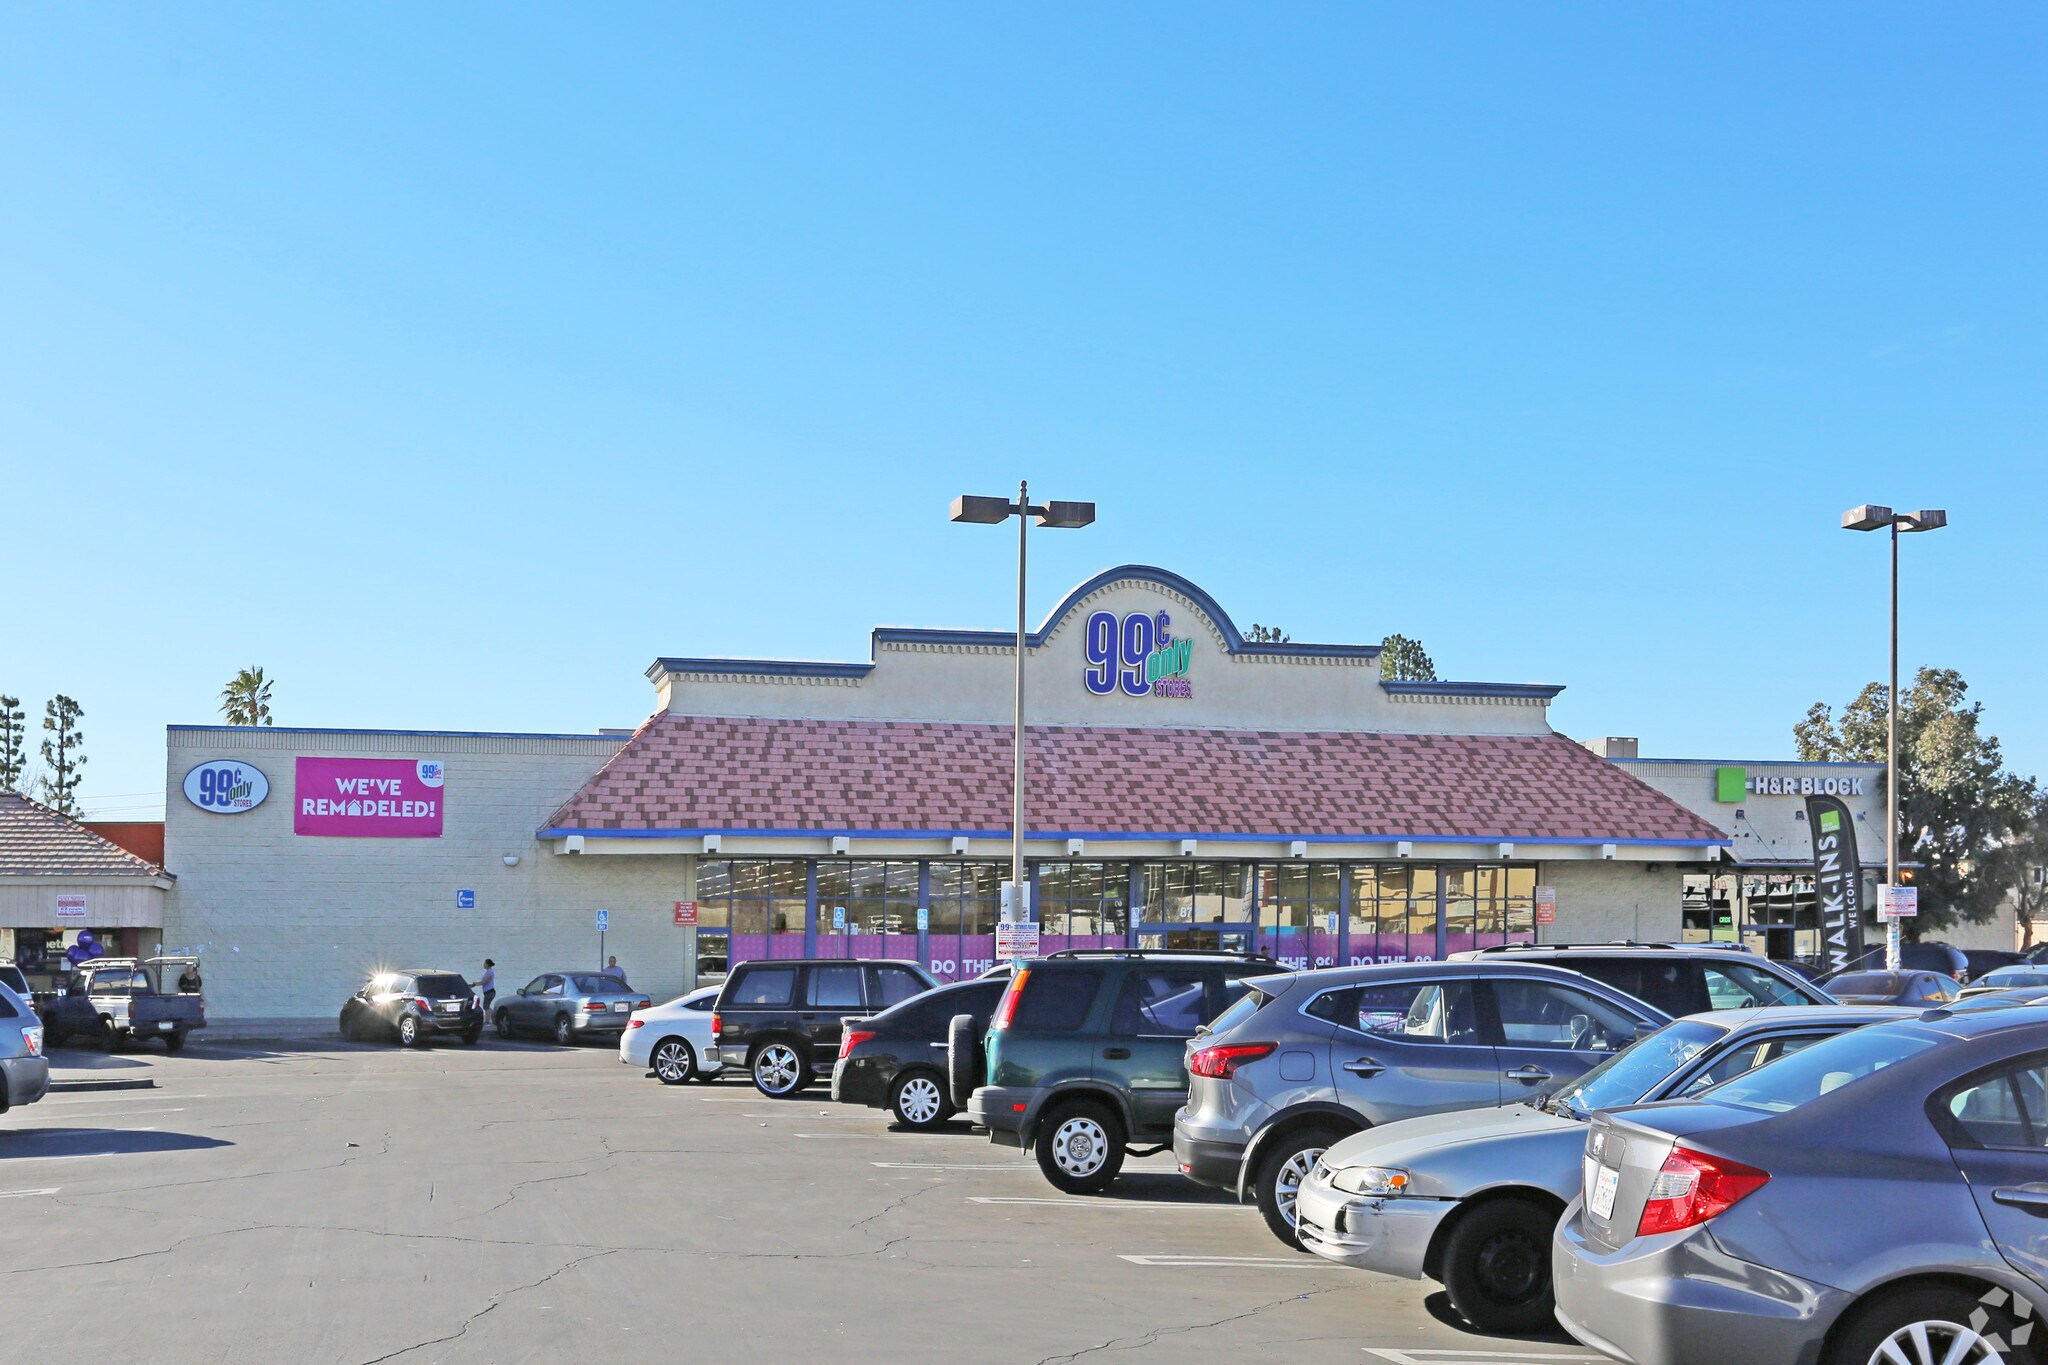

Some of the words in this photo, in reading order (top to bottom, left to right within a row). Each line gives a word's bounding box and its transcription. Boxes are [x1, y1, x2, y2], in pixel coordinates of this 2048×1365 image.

[1147, 638, 1193, 683] only
[1156, 680, 1192, 698] STORES
[230, 781, 253, 800] only
[335, 778, 401, 796] WE'VE
[1755, 777, 1795, 795] H&R
[1801, 777, 1863, 795] BLOCK
[1818, 834, 1849, 973] WALK-INS
[1845, 871, 1858, 929] WELCOME
[931, 959, 956, 974] DO
[963, 959, 994, 974] THE
